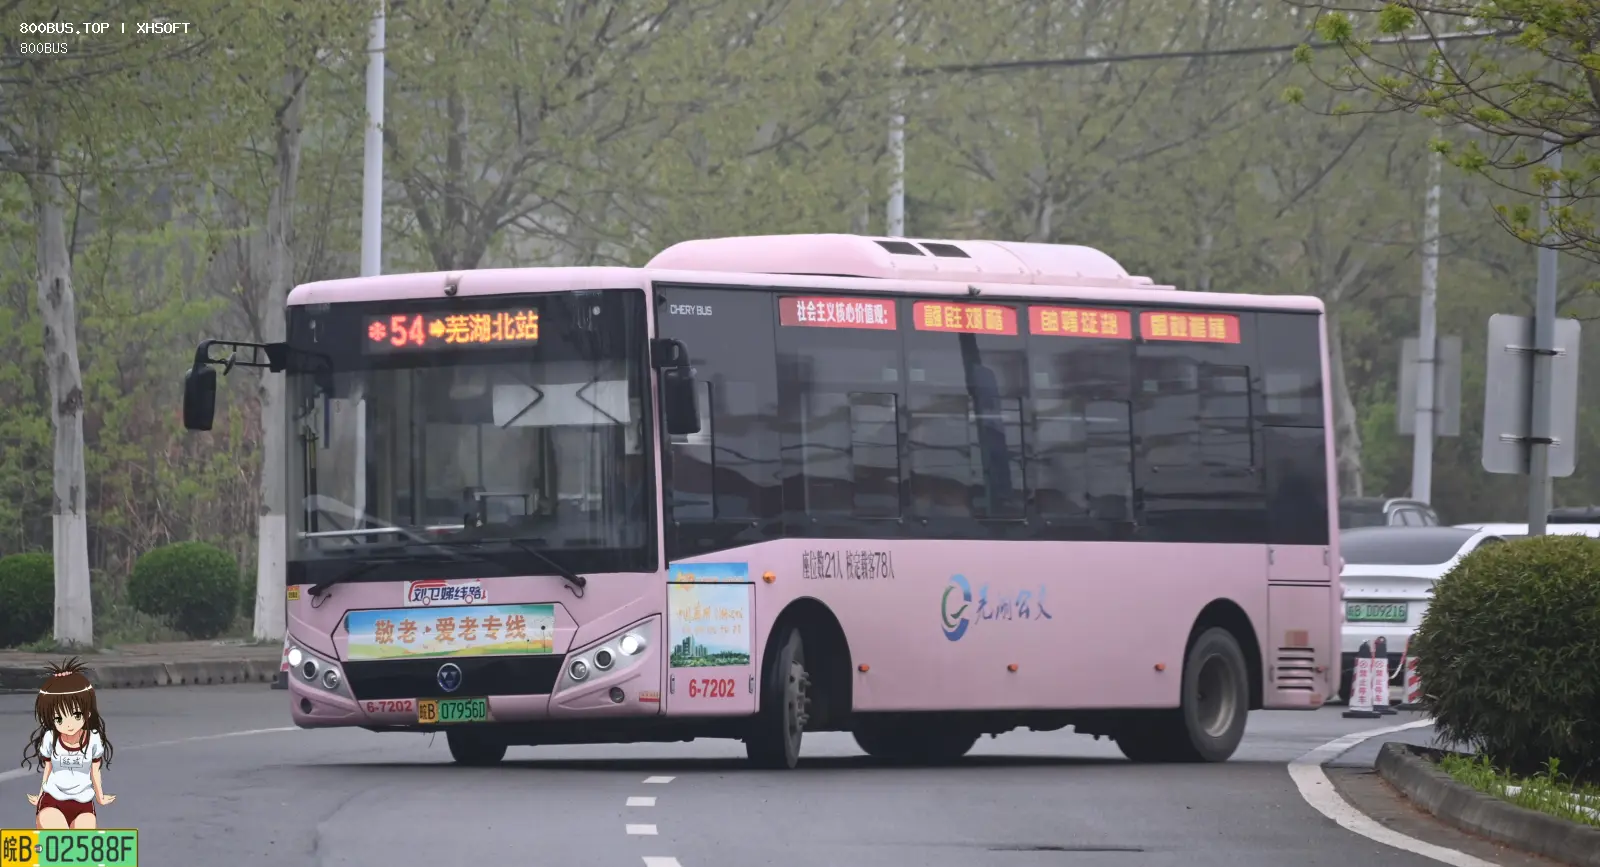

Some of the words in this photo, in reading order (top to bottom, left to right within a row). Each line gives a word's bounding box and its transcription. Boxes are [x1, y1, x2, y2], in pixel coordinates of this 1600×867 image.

[670, 304, 695, 315] CHERY
[696, 305, 713, 316] BUS
[389, 314, 427, 347] 54
[444, 309, 539, 344] 芜湖北站
[688, 678, 736, 698] 6-7202
[366, 700, 414, 713] 6-7202
